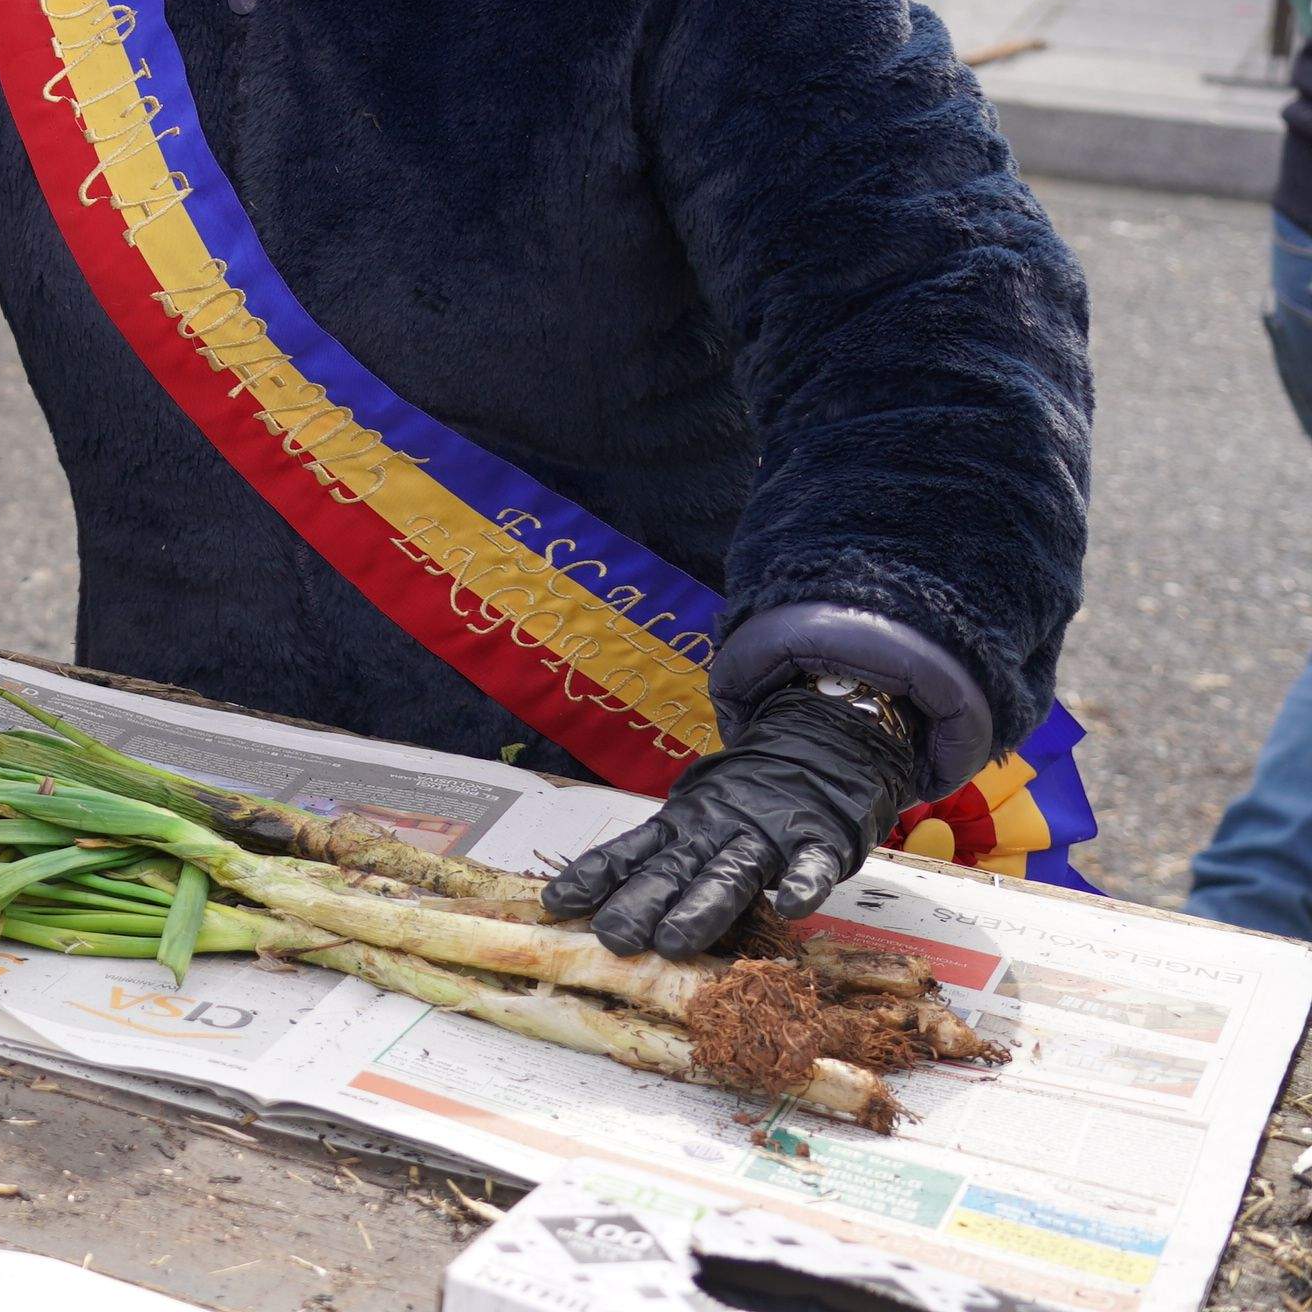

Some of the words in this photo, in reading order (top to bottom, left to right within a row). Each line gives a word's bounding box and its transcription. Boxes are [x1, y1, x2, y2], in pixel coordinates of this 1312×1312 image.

[152, 256, 431, 505] 2024-2025
[478, 506, 714, 692] ESCALD
[106, 984, 253, 1032] CISA
[555, 1217, 657, 1252] 100
